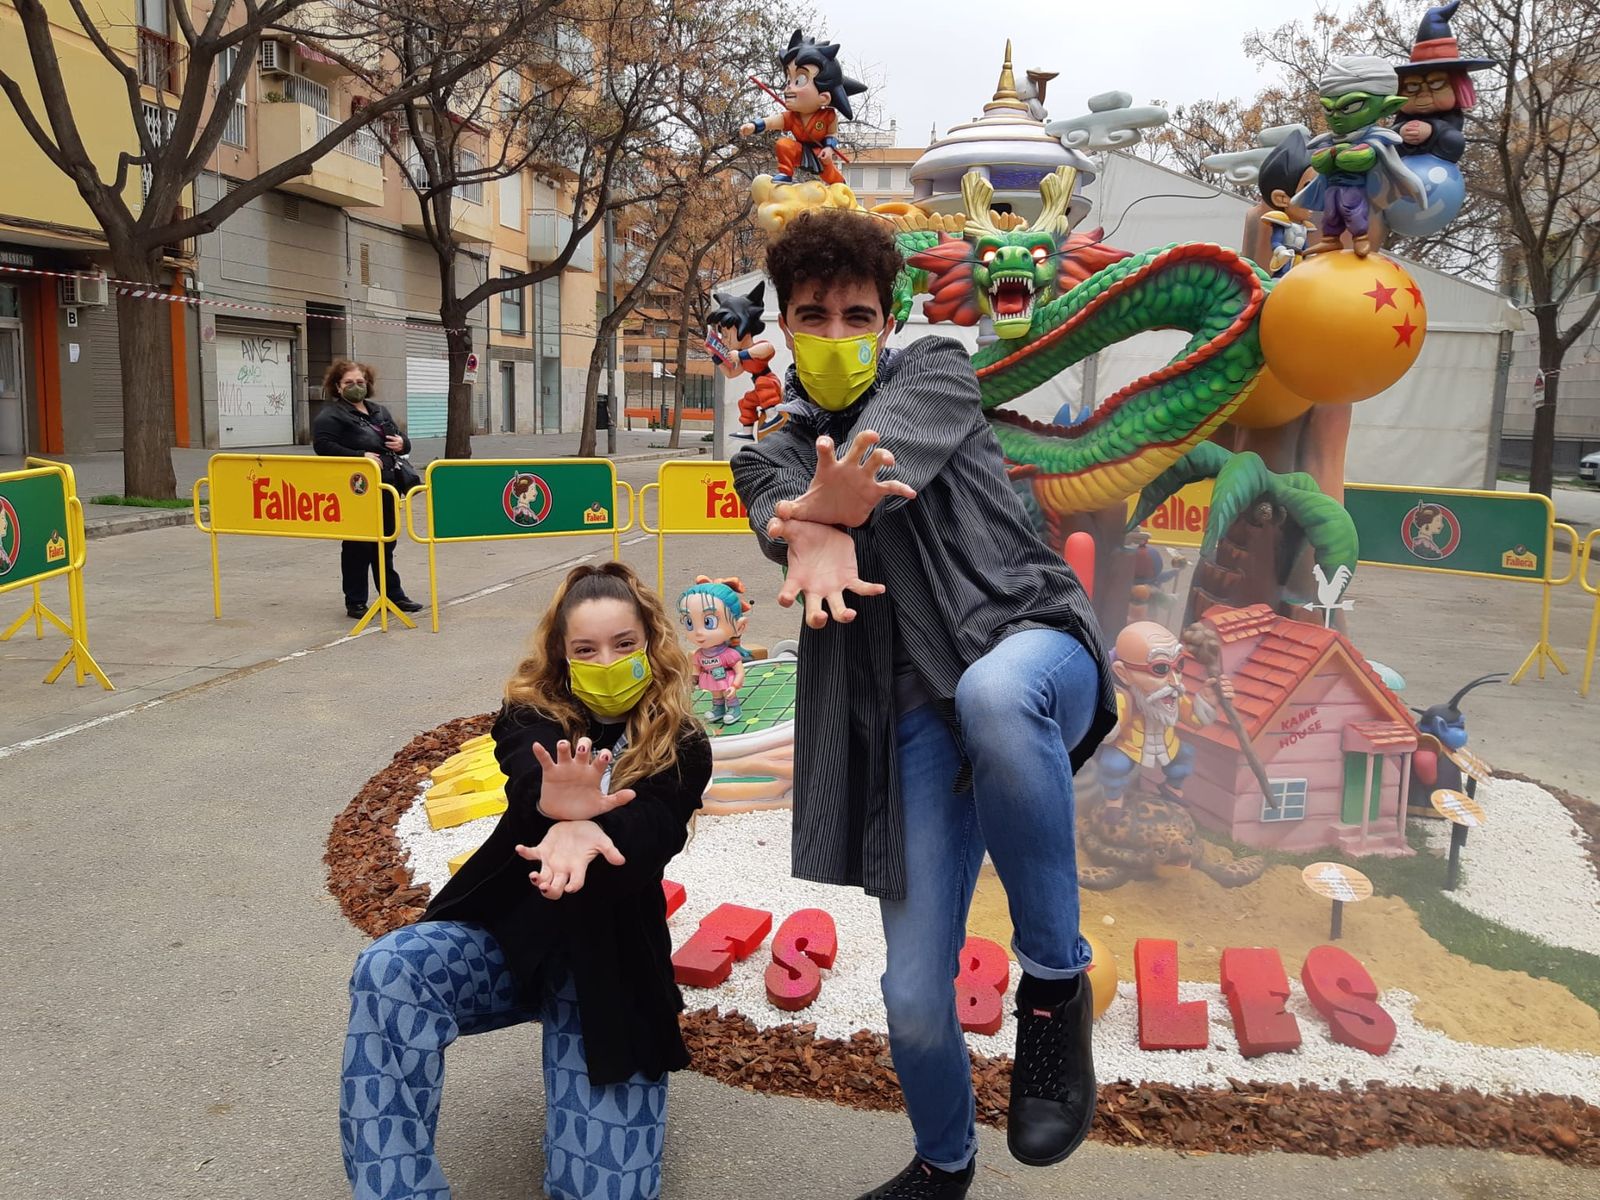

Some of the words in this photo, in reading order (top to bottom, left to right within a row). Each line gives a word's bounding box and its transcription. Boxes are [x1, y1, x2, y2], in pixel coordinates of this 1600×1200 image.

[69, 312, 76, 324] B
[253, 478, 341, 522] Fallera
[1505, 555, 1535, 568] Fallera
[1281, 706, 1318, 731] KAME
[1280, 719, 1322, 749] HOUSE
